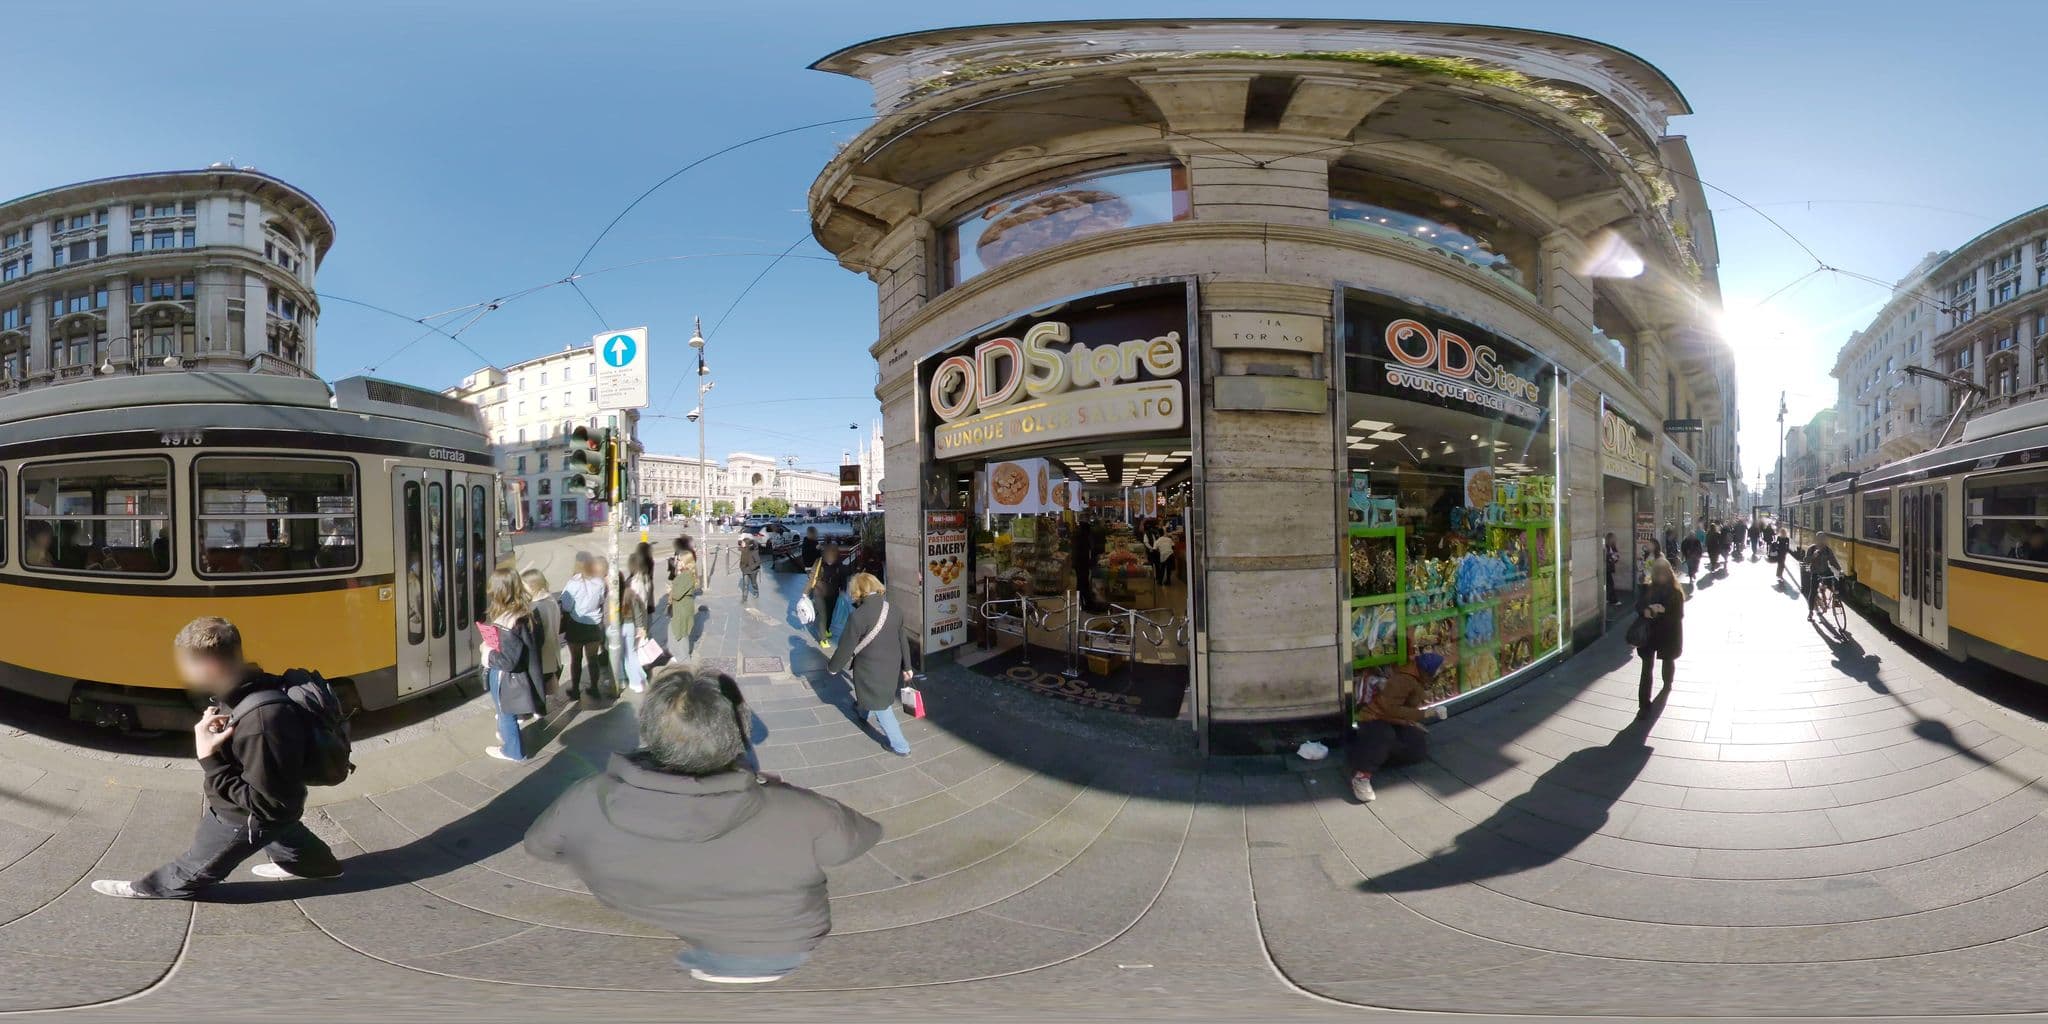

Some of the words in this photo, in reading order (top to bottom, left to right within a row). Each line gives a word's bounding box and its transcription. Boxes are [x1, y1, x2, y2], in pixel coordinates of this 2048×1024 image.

[1259, 319, 1281, 327] IA
[1233, 333, 1303, 343] TORNO
[931, 322, 1181, 421] ODStore
[1385, 319, 1539, 402] ODStore
[1386, 371, 1464, 401] OVUNQUE
[937, 421, 1004, 451] OVUNQUE
[429, 448, 465, 462] entrata
[928, 542, 966, 556] BAKERY
